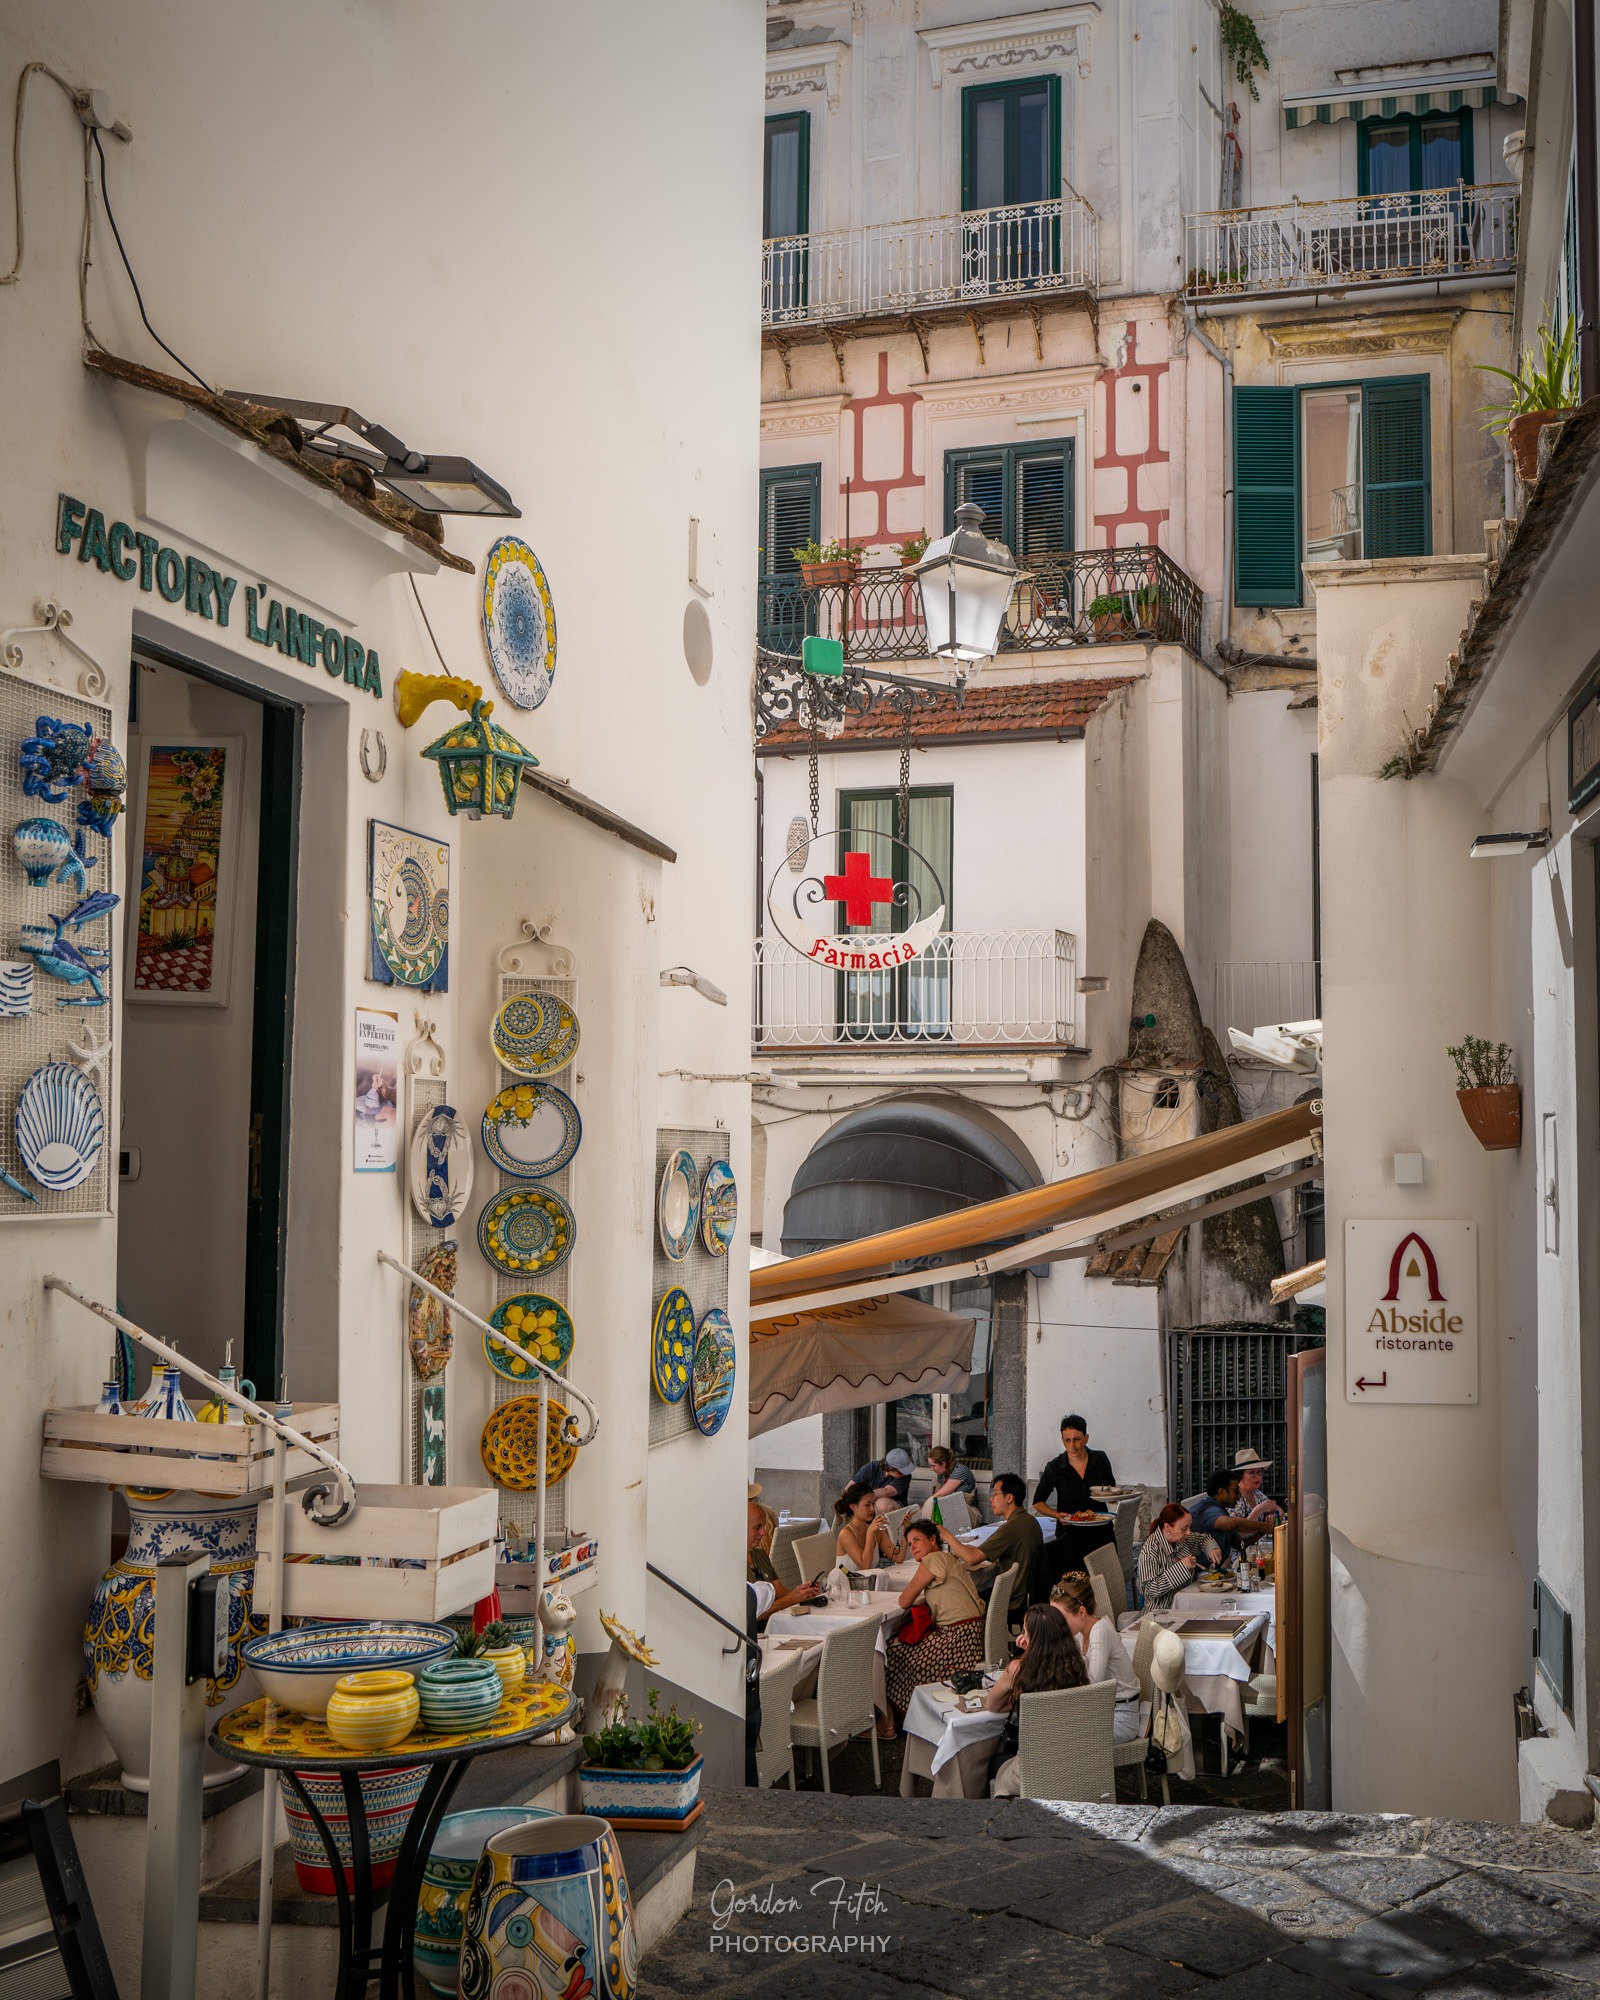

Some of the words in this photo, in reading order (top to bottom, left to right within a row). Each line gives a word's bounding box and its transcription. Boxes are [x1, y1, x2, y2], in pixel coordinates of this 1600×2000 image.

[56, 493, 237, 627] FACTORY
[246, 584, 384, 699] L'ANFORA
[807, 938, 917, 970] Farmacia
[1366, 1307, 1463, 1334] Abside
[1376, 1336, 1454, 1351] ristorante
